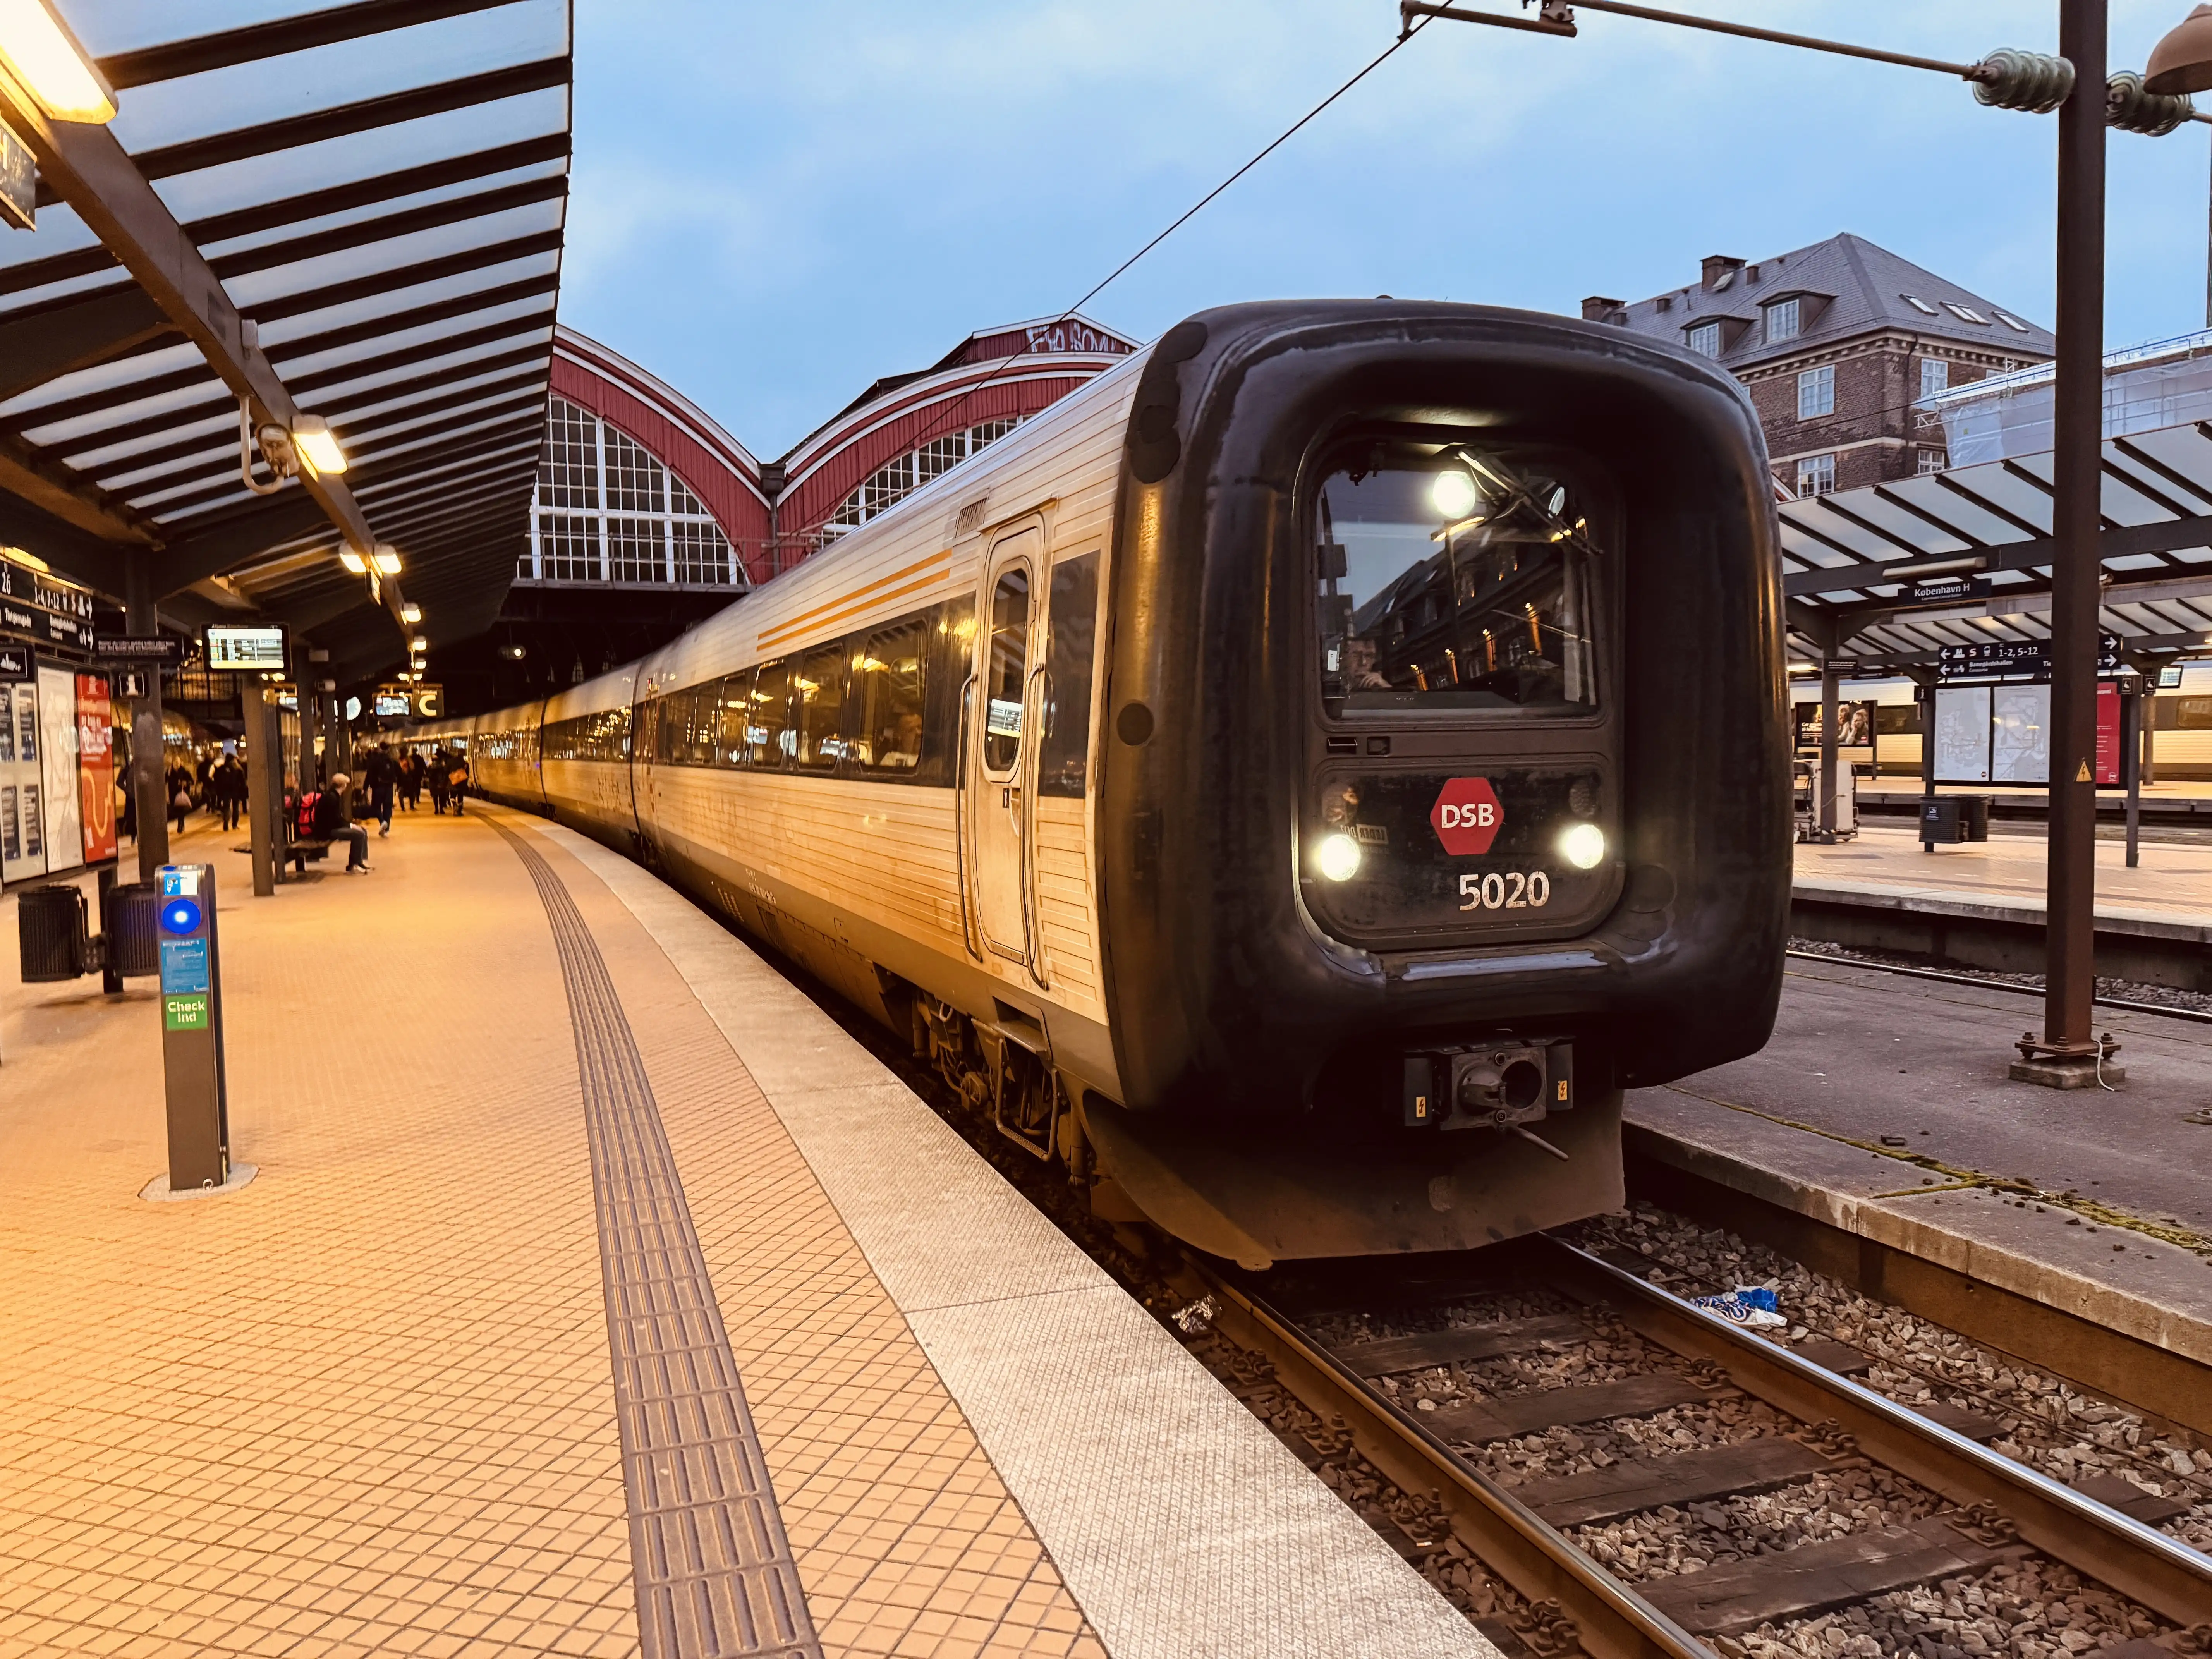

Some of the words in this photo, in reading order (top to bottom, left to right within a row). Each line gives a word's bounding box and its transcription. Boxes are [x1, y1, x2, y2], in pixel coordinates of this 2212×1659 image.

[1914, 585, 1961, 597] København
[1963, 583, 1970, 591] H
[2017, 647, 2039, 656] 5-12
[419, 694, 437, 716] C
[1441, 803, 1495, 828] DSB
[1458, 871, 1549, 911] 5020
[168, 1000, 205, 1012] Check
[177, 1011, 197, 1023] Ind
